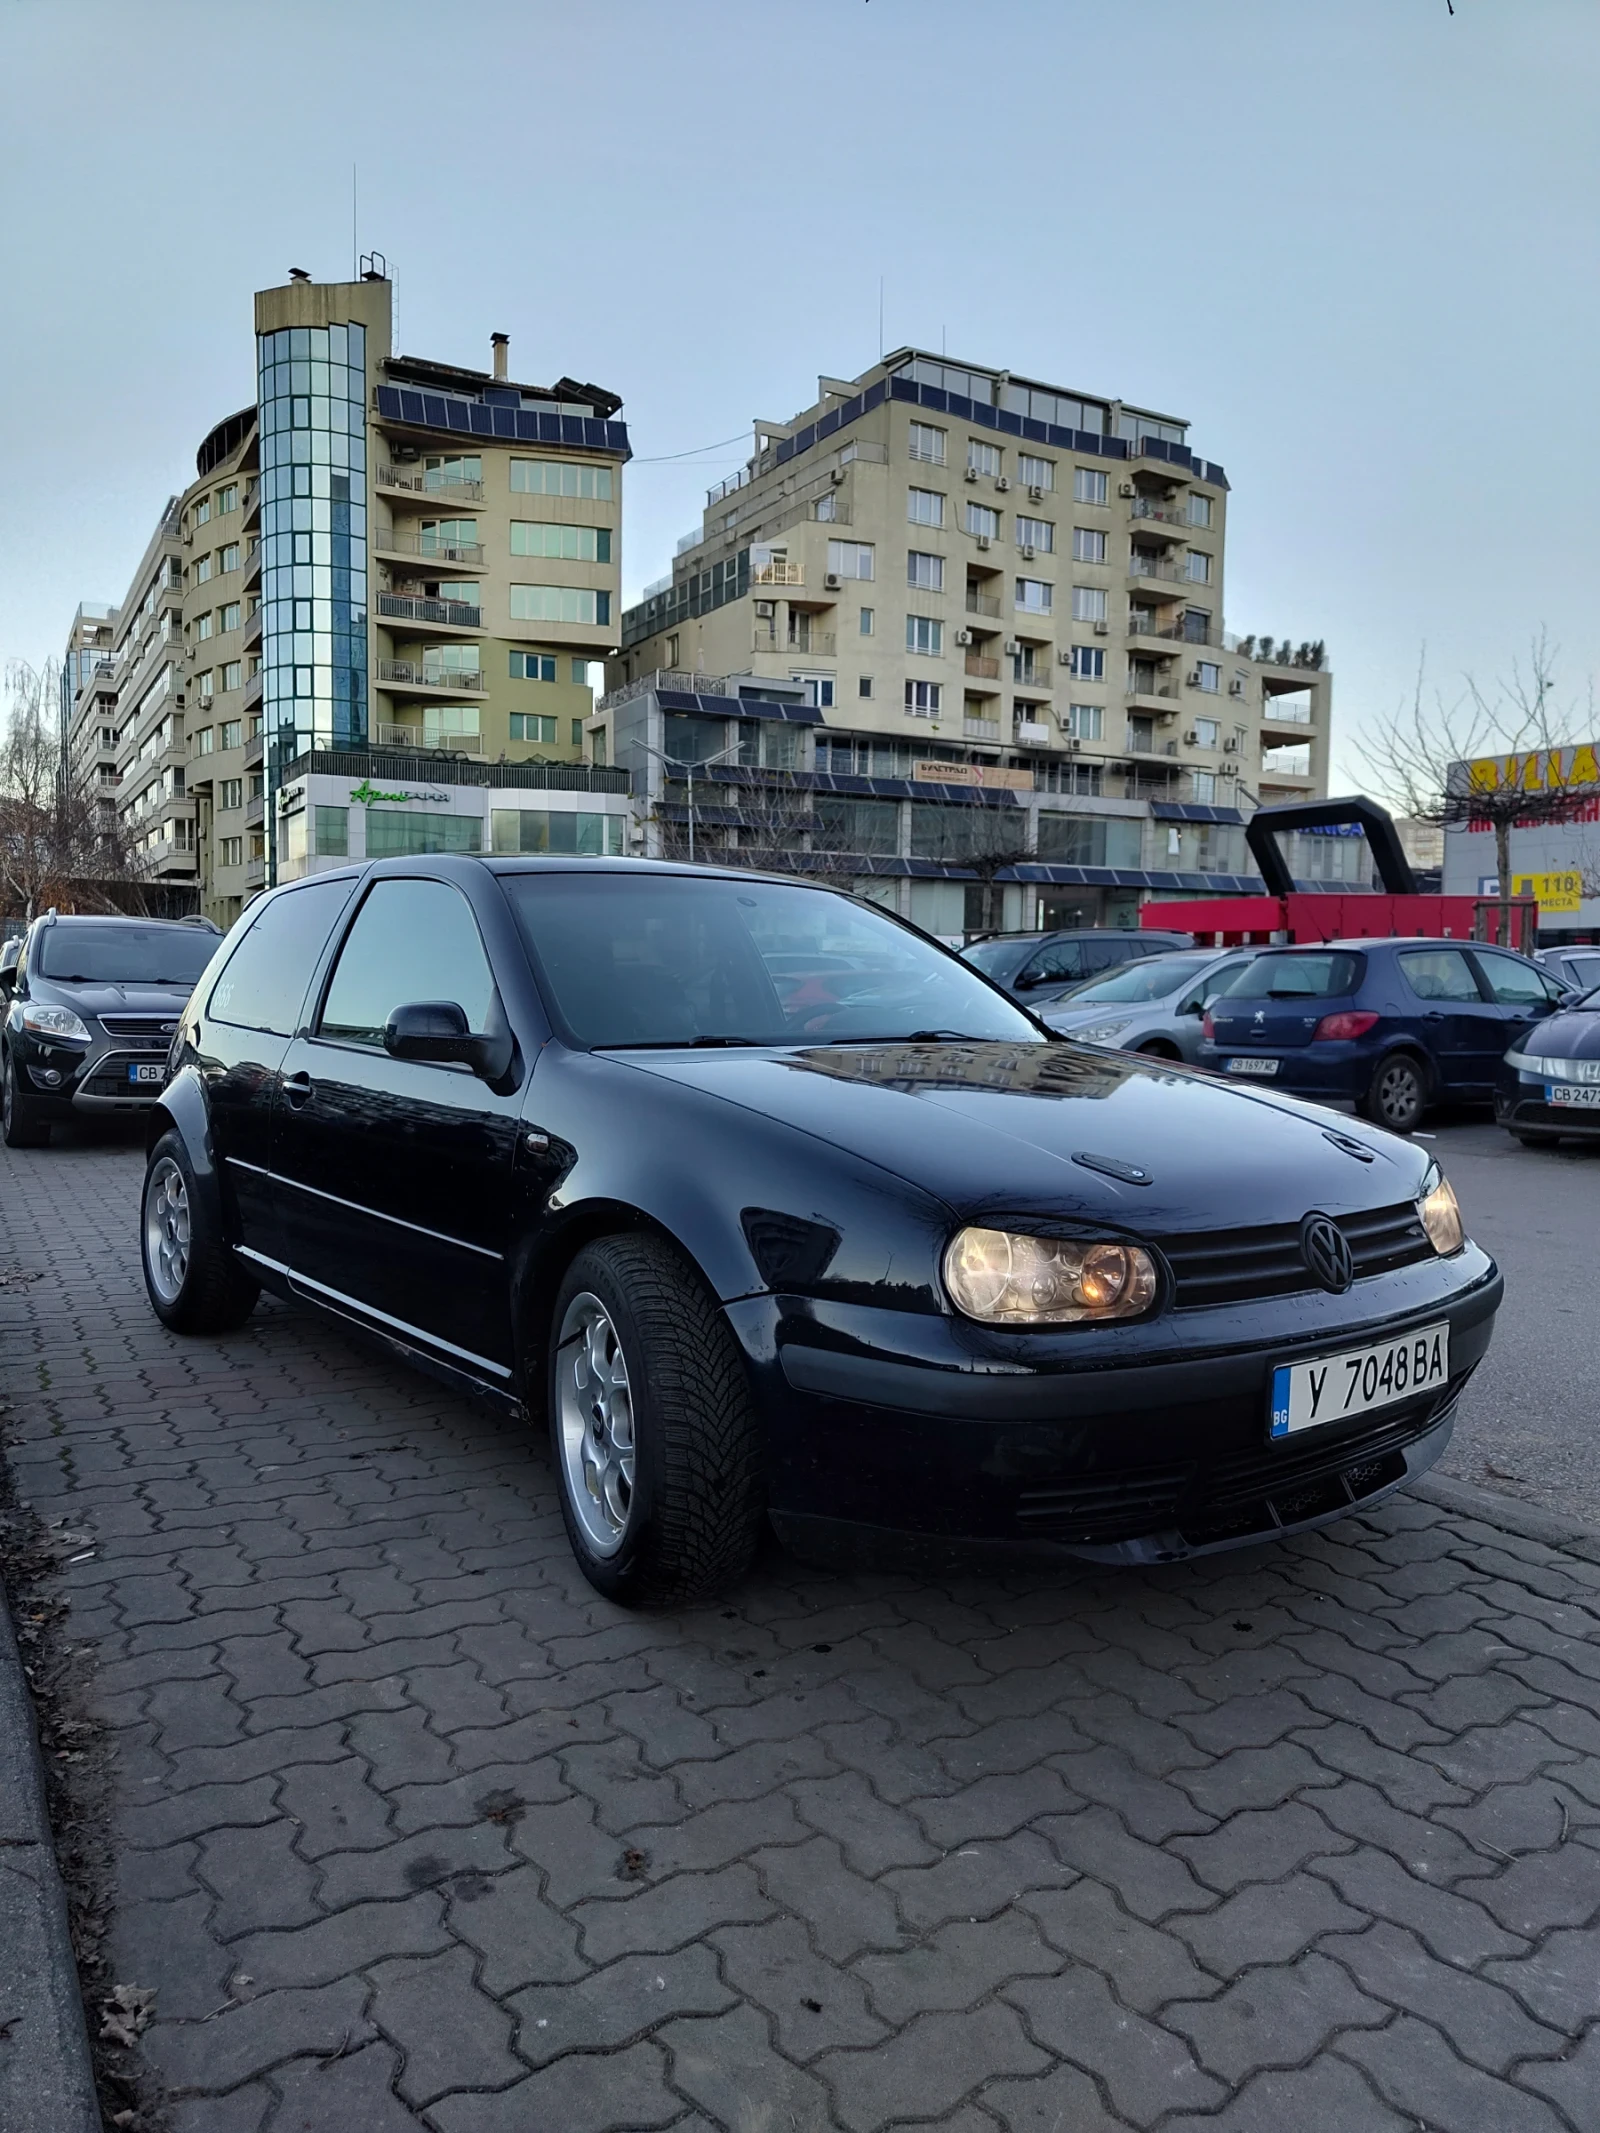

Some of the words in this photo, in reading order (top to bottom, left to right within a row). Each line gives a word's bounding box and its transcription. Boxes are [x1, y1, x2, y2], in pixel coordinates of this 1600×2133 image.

[1470, 746, 1600, 795] BILLA
[1542, 877, 1575, 893] 110
[1541, 897, 1573, 907] МЕСТА
[1273, 1409, 1288, 1426] BG
[1343, 1346, 1408, 1409] 7048
[1413, 1333, 1443, 1386] BA
